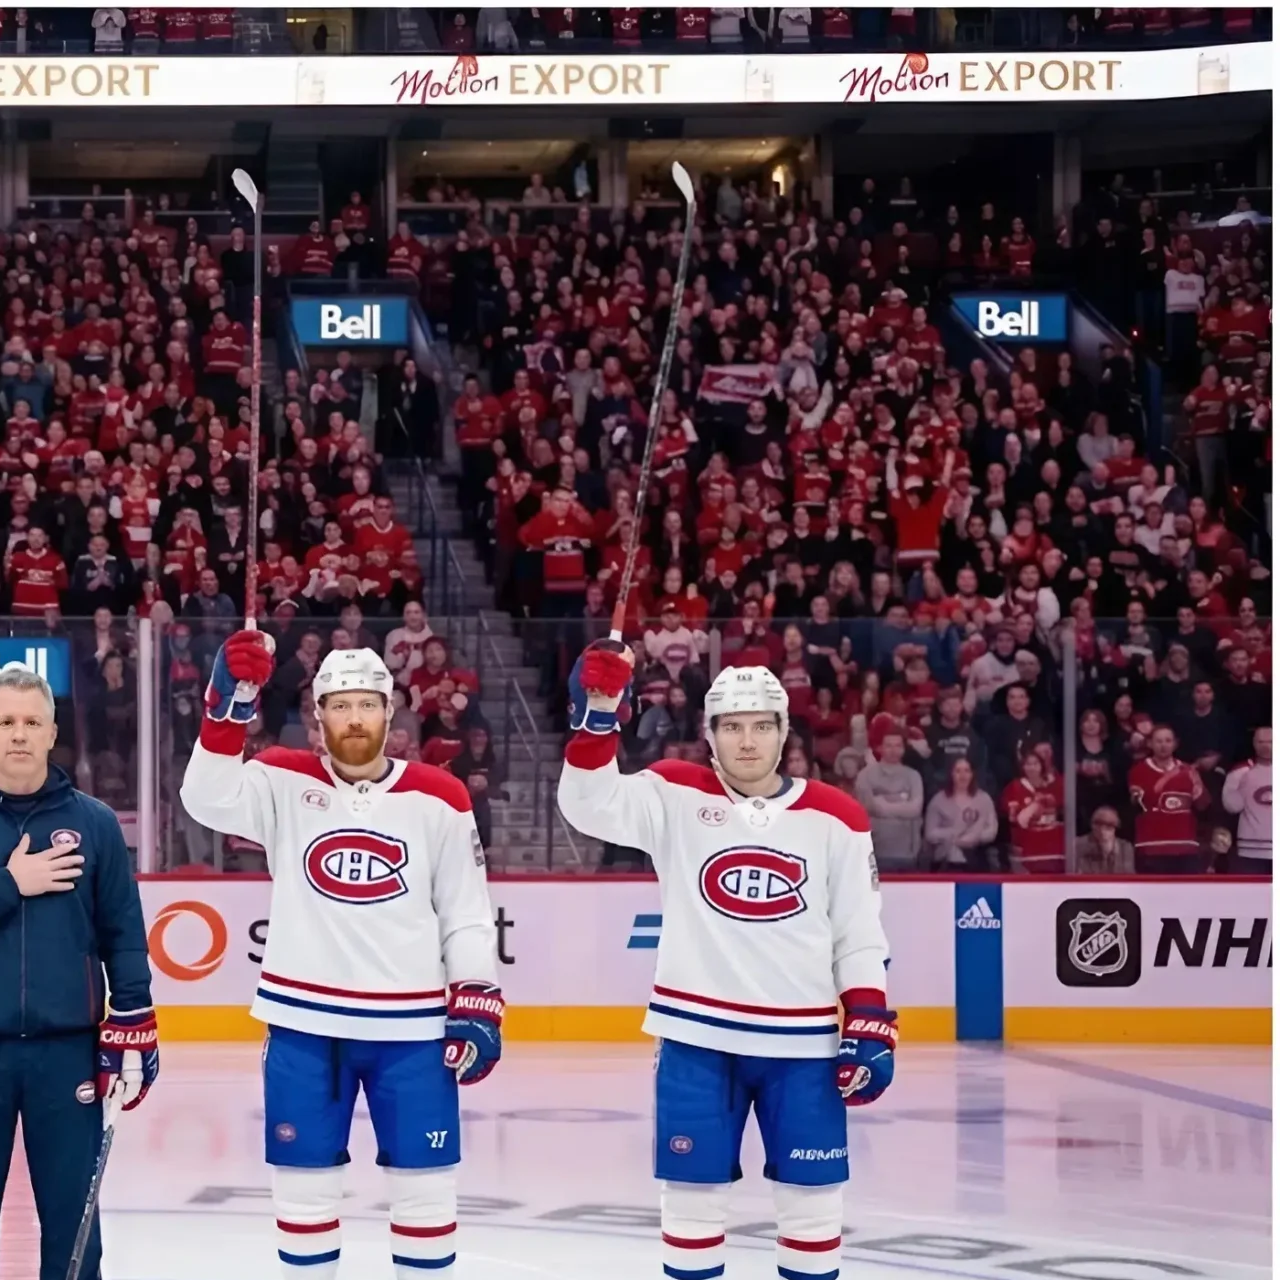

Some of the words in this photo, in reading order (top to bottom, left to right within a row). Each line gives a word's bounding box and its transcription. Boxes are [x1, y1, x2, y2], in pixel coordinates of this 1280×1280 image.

[509, 64, 670, 95] EXPORT
[959, 60, 1122, 91] EXPORT
[321, 304, 380, 339] Bell
[978, 300, 1039, 337] Bell
[1154, 918, 1273, 967] NH
